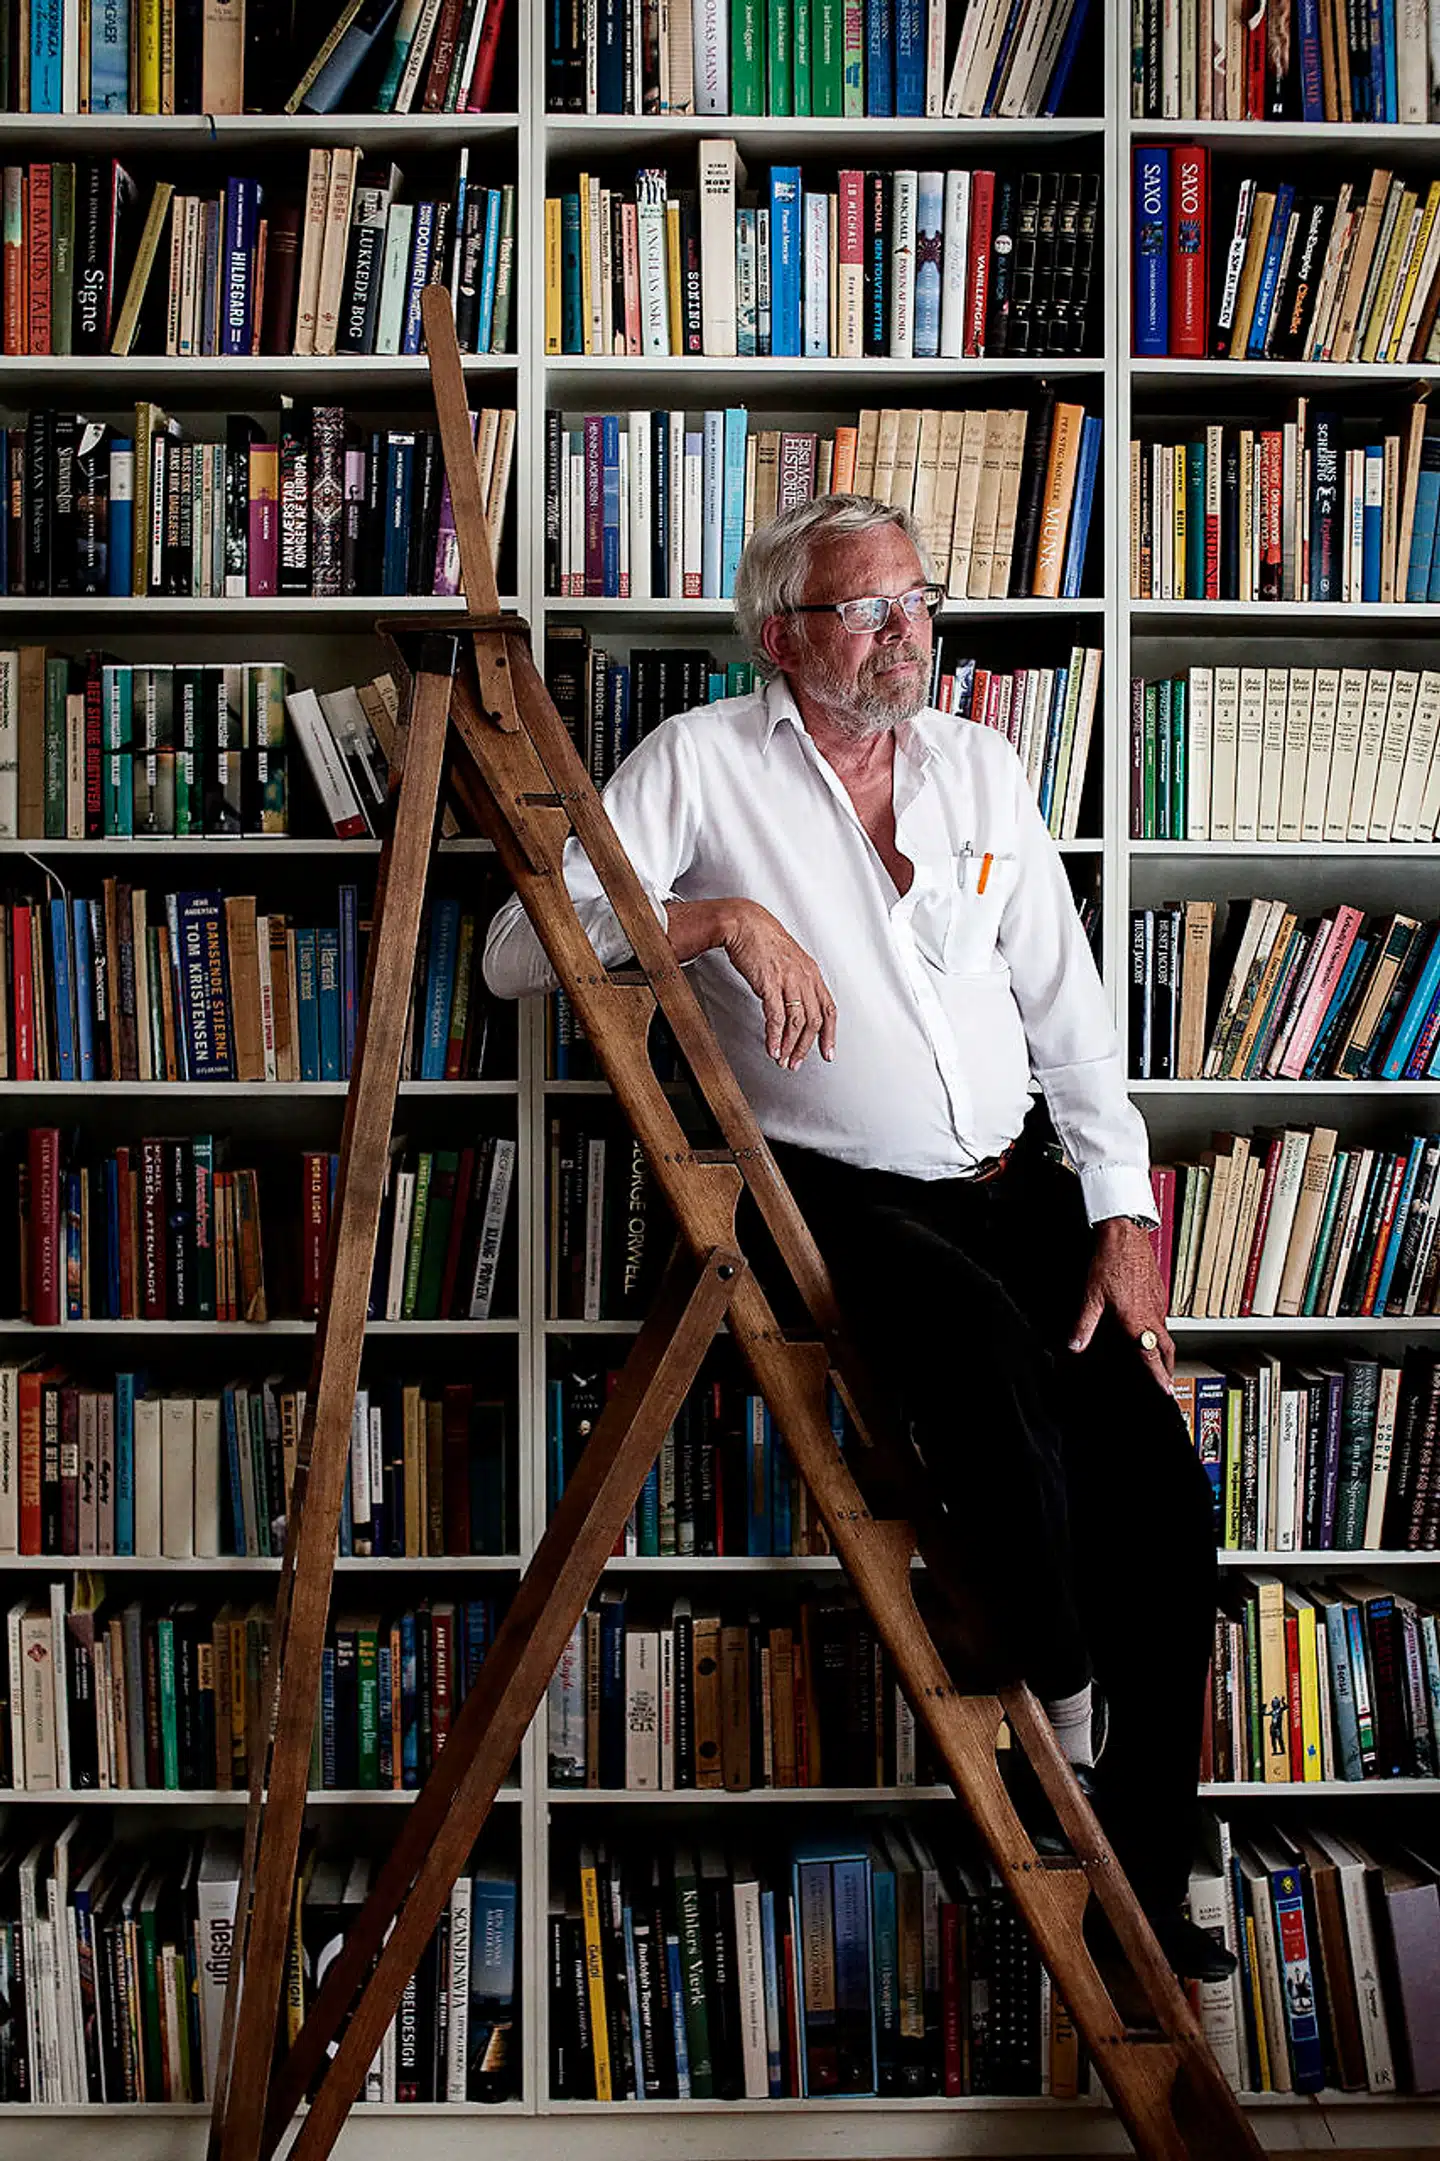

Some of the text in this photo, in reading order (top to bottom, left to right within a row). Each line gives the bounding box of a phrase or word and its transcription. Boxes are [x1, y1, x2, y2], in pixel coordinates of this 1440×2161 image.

[434, 41, 453, 74] Kaija
[706, 46, 717, 92] MANN
[874, 191, 882, 232] MICHAEL
[900, 183, 909, 193] IB
[1144, 163, 1161, 214] SAXO
[1181, 163, 1199, 214] SAXO
[846, 201, 857, 250] MICHAEL
[898, 194, 908, 242] MICHAEL
[32, 168, 49, 336] FRI MANDS TALE
[352, 228, 374, 302] LUKKEDE
[413, 227, 430, 287] DOMMEN
[496, 237, 513, 296] Visse hensyn
[898, 258, 907, 289] PAVEN
[77, 269, 104, 332] Signe
[229, 251, 246, 327] HILDEGARD
[687, 271, 701, 329] SONING
[348, 305, 368, 339] BOG
[897, 303, 906, 340] INDIEN
[169, 447, 180, 471] HANS
[588, 421, 598, 458] HENNING
[798, 438, 812, 465] Elsa
[1316, 423, 1329, 481] SCHERFIG
[1327, 450, 1337, 481] HANS
[168, 473, 180, 493] KIRK
[294, 454, 308, 569] KONGEN AF EUROPA
[589, 461, 597, 507] MORTENSEN
[1040, 416, 1068, 569] PER STIG MØLLER MUNK
[282, 480, 295, 569] JAN KJÆRSTAD
[1206, 515, 1219, 598] ORDENE
[87, 707, 101, 744] STORE
[614, 689, 622, 723] Murdoch
[1133, 919, 1145, 985] HUSET JACOBY
[1157, 919, 1169, 986] HUSET JACOBY
[185, 922, 209, 1061] TOM KRISTENSEN
[205, 921, 228, 1060] DANSENDE STJERNE
[311, 1157, 321, 1224] WORLD LIGHT
[144, 1145, 156, 1305] LARSEN AFTENLANDET
[624, 1217, 646, 1295] ORWELL
[1283, 1401, 1293, 1442] Strindberg
[1350, 1462, 1362, 1477] fra
[207, 1920, 234, 1985] design
[453, 1907, 468, 2009] SCANDINAVIA
[682, 1890, 707, 2006] Kählers Værk
[637, 1942, 653, 2027] Rudolph Tegner
